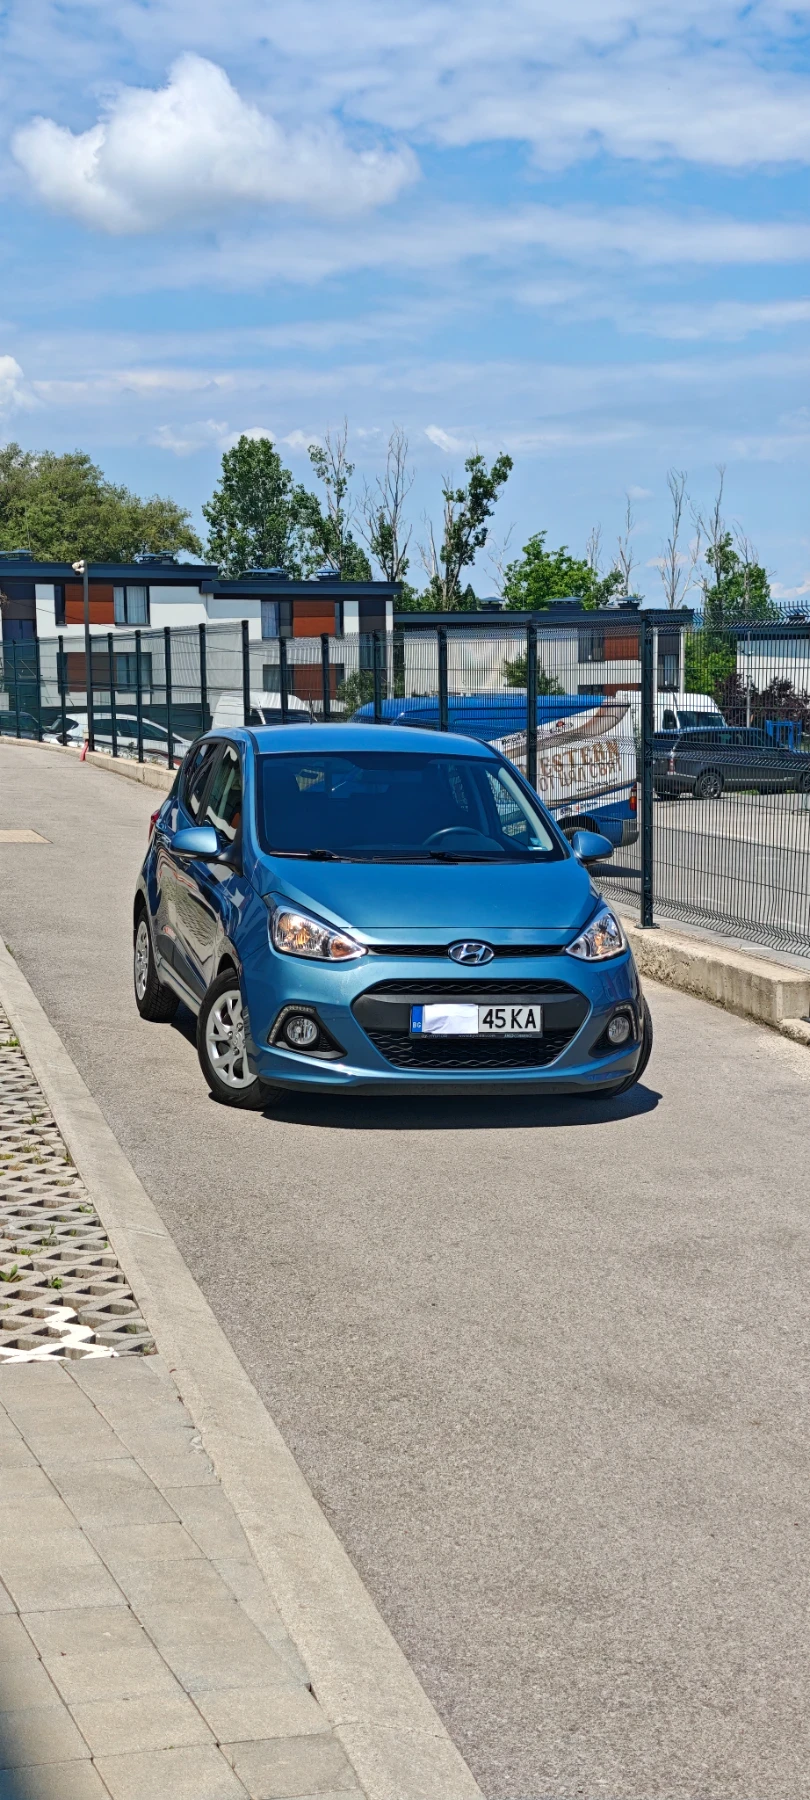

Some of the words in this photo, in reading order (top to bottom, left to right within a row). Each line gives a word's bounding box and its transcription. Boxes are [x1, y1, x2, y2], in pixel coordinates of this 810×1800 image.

[538, 739, 619, 775] ESTERN
[482, 1009, 506, 1028] 45
[511, 1009, 536, 1028] KA
